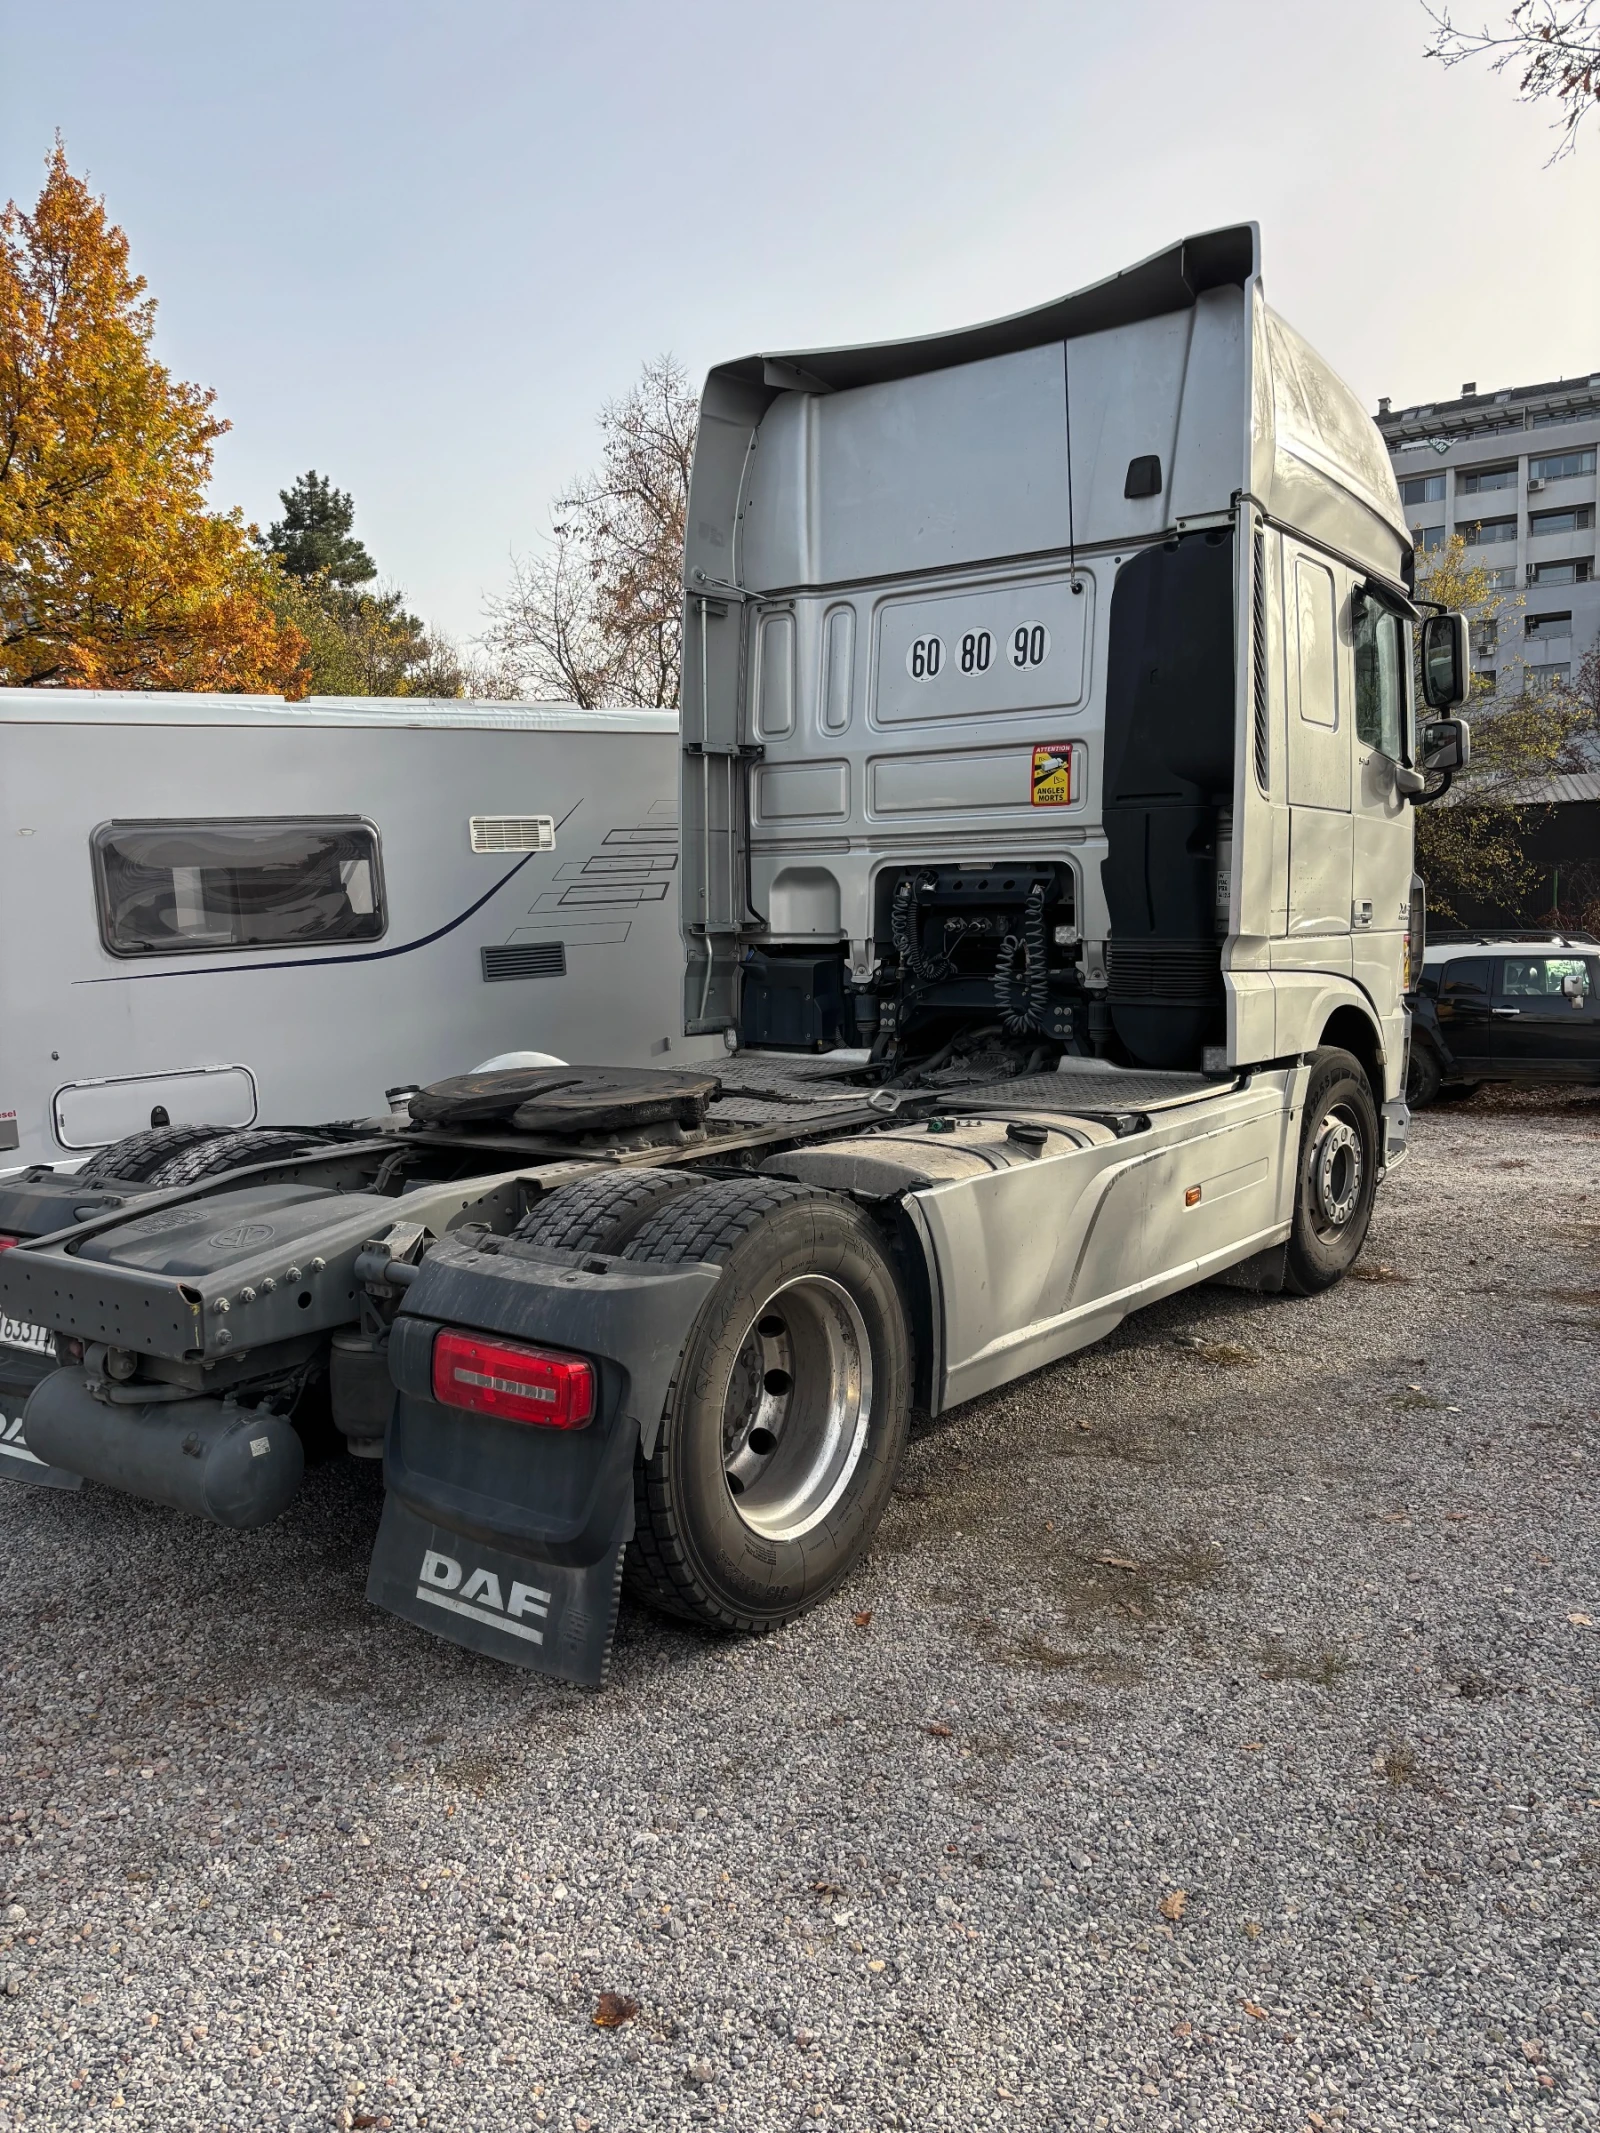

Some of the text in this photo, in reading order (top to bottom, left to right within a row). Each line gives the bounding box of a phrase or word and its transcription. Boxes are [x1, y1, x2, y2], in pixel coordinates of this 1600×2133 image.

[912, 625, 1045, 678] 60 80 90
[0, 1109, 17, 1119] sel
[419, 1549, 552, 1619] DAF
